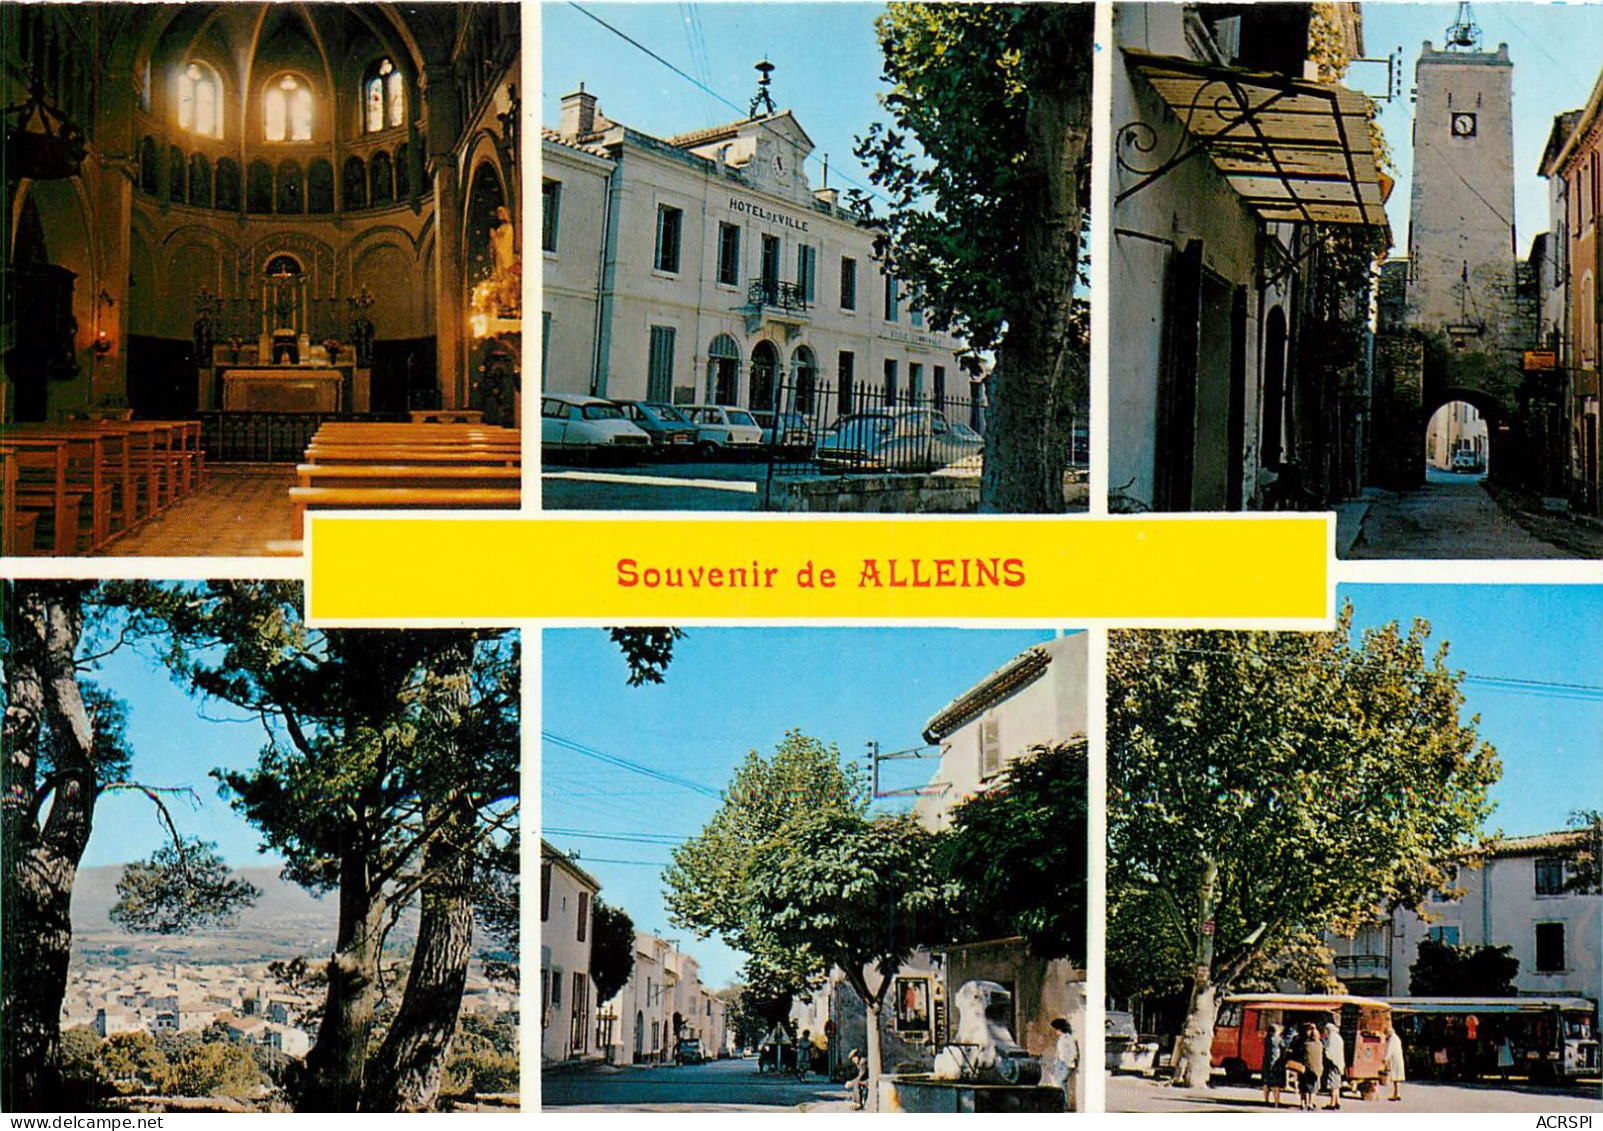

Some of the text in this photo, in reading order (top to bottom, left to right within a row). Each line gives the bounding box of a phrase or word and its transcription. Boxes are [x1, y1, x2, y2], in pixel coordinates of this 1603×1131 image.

[729, 198, 767, 218] HOTEL
[779, 213, 809, 232] VILLE
[616, 557, 1026, 588] Souvenir de ALLEINS
